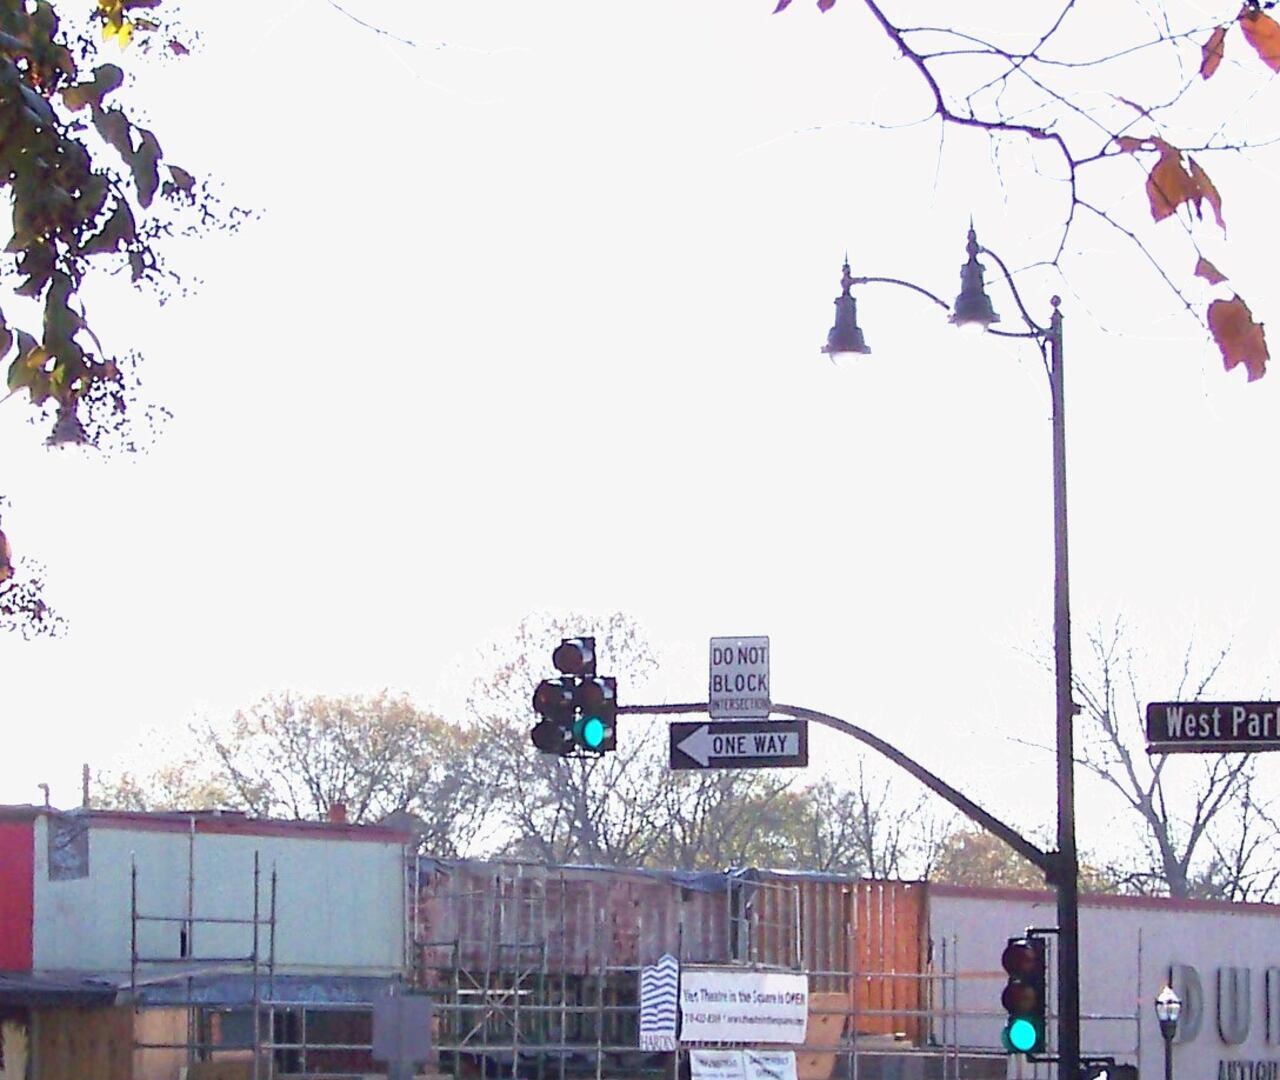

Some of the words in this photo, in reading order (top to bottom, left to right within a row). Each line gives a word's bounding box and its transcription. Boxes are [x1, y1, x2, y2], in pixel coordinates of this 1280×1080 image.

[712, 647, 734, 666] DO
[738, 646, 767, 665] NOT
[713, 673, 768, 693] BLOCK
[1166, 706, 1221, 738] West
[712, 736, 747, 754] ONE
[753, 735, 787, 754] WAY
